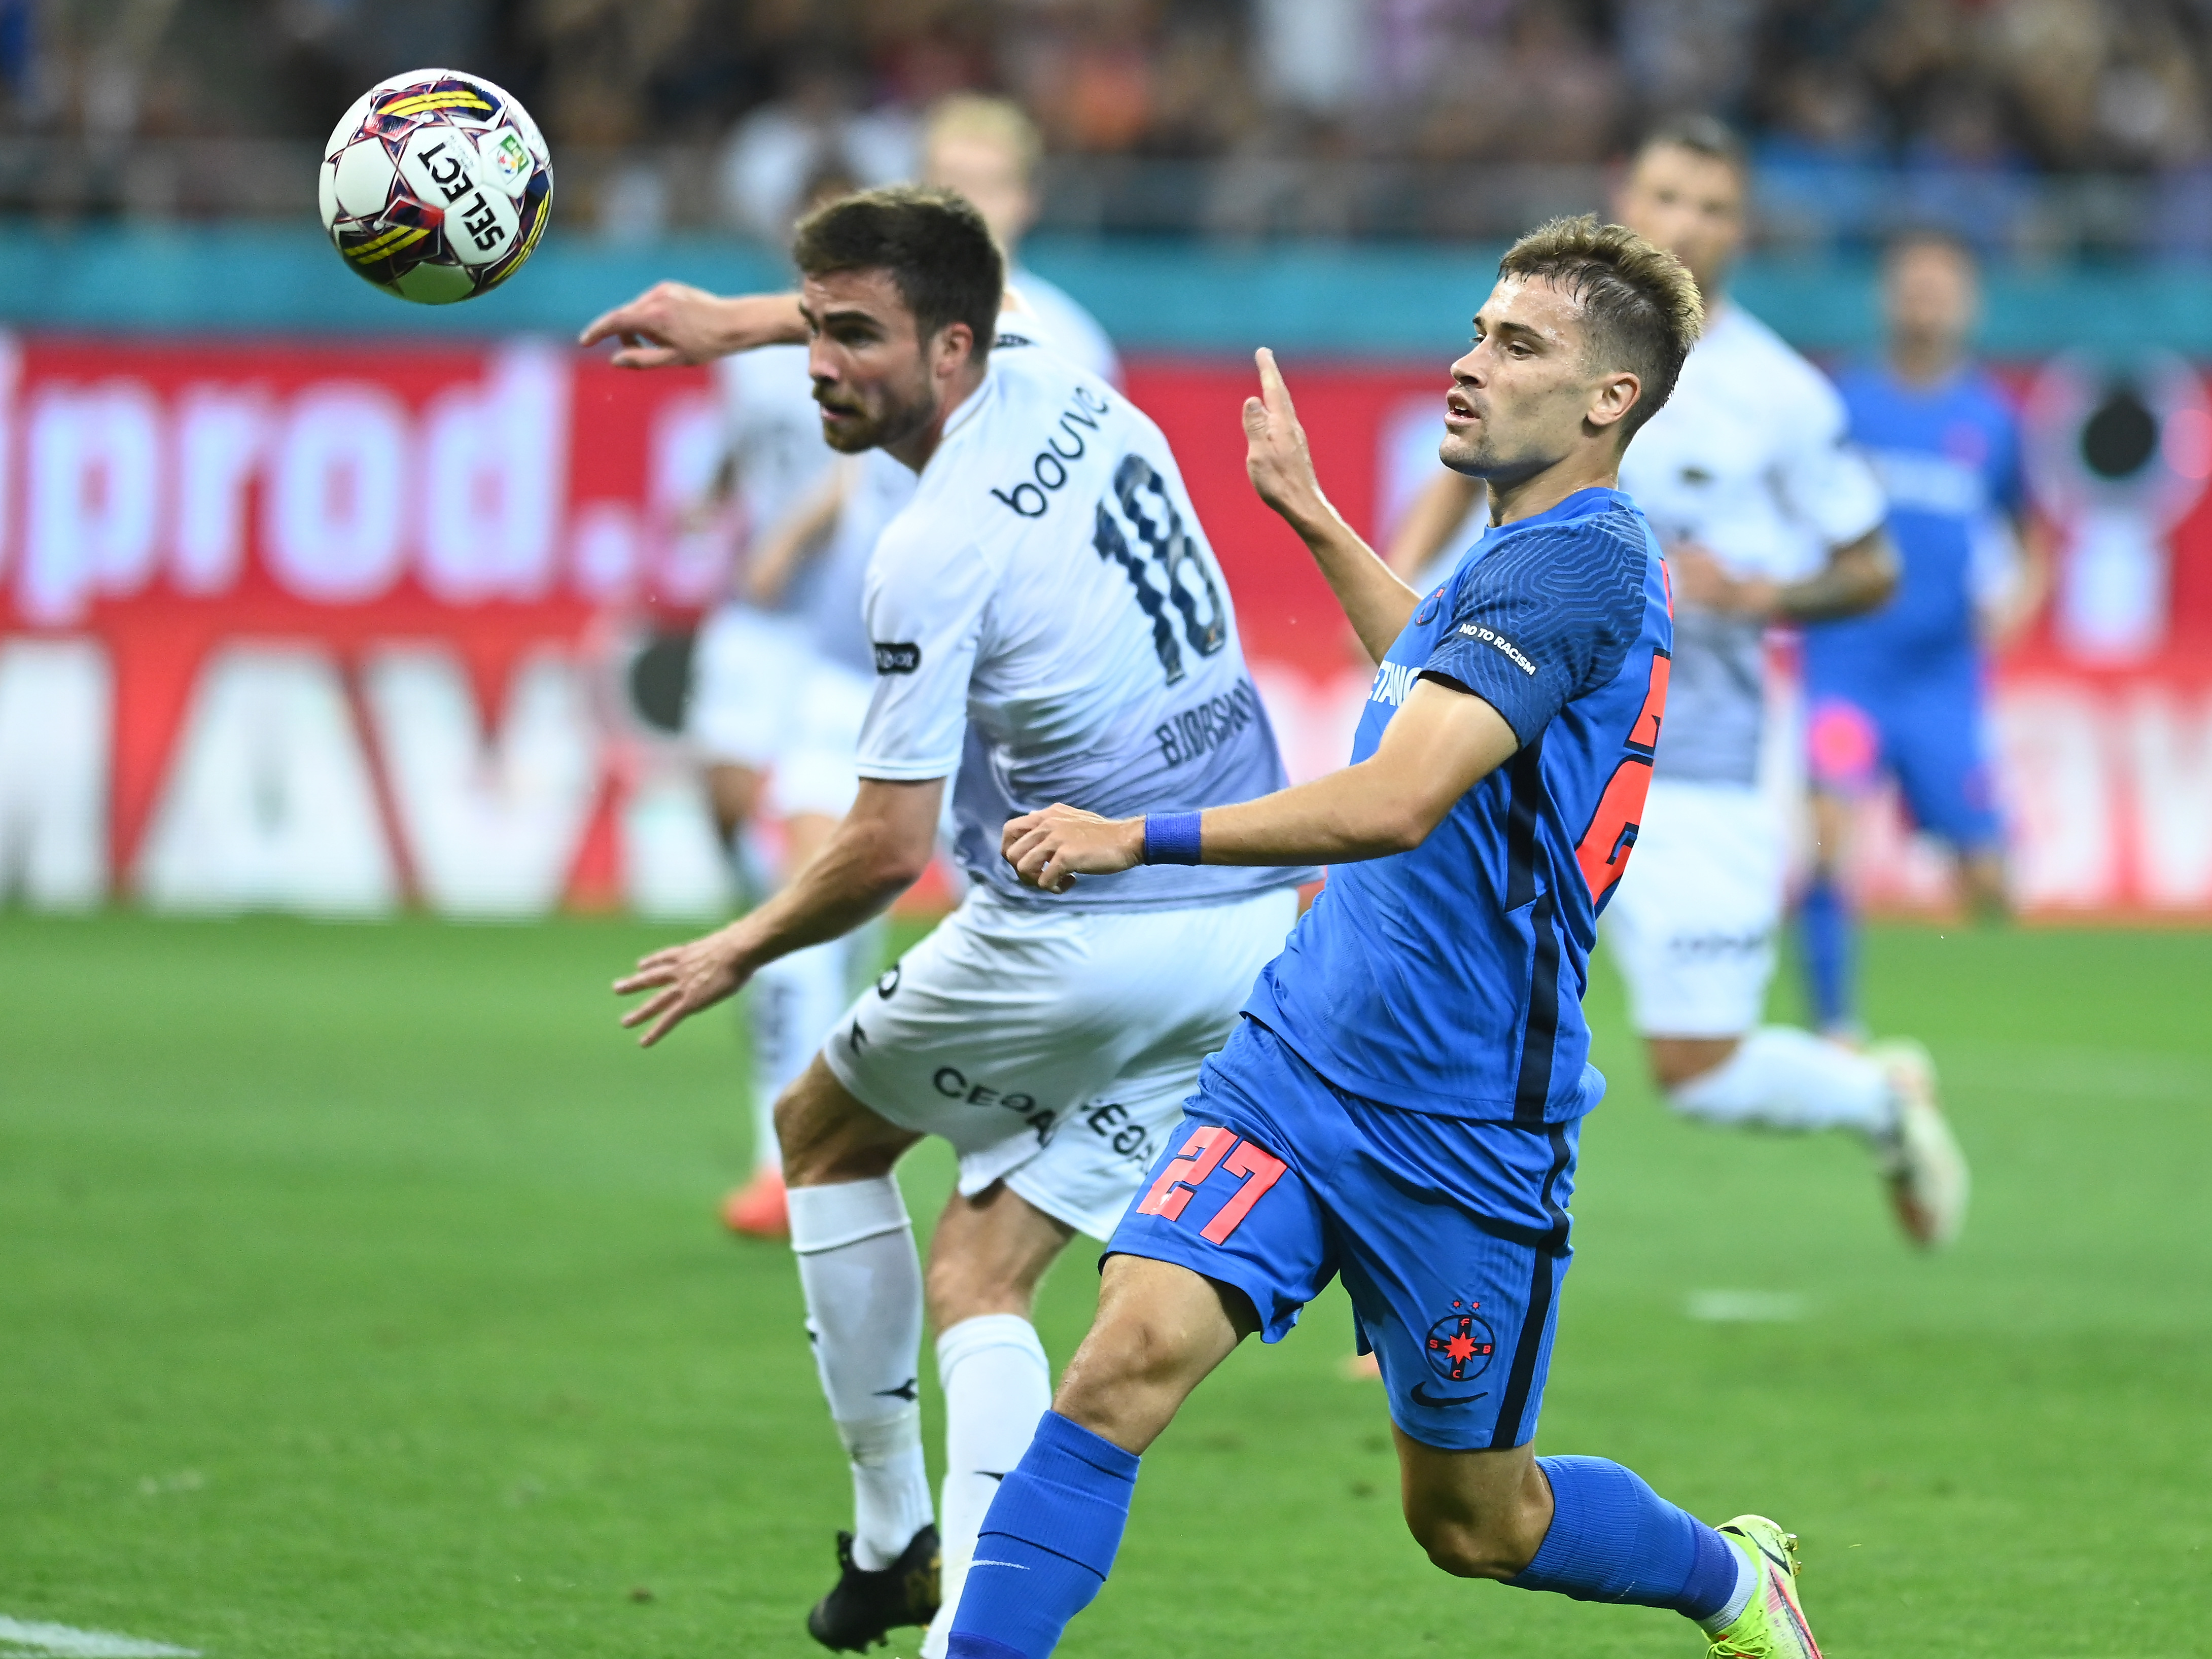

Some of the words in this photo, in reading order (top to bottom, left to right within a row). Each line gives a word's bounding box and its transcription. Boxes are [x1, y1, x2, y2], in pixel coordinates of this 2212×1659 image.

[417, 142, 506, 252] SELECT
[1092, 454, 1228, 687] 18
[1459, 623, 1478, 636] NO
[1477, 628, 1495, 642] TO
[1493, 636, 1536, 676] RACISM
[1136, 1125, 1288, 1246] 27
